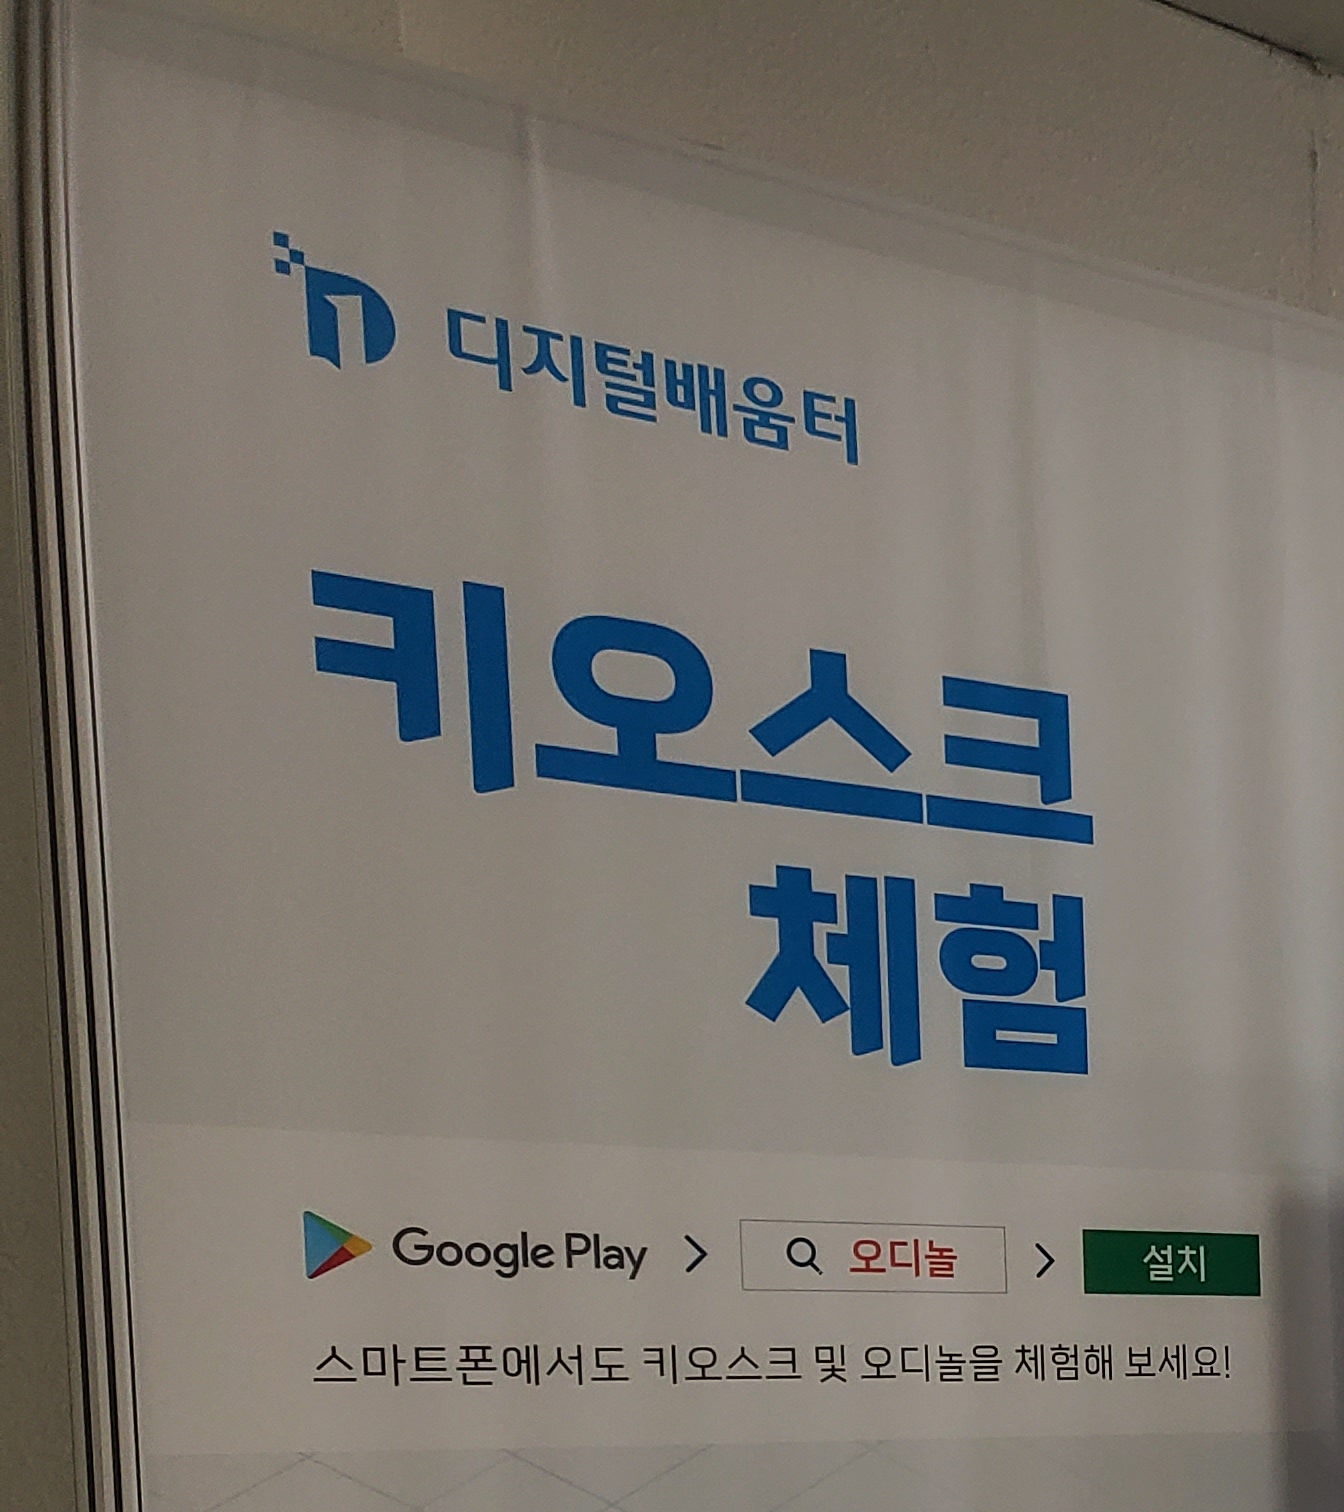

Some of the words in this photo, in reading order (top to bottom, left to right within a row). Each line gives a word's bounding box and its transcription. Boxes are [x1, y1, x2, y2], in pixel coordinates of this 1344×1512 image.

[447, 308, 859, 466] 디지털배움터
[311, 569, 1094, 845] 키오스크
[745, 864, 1089, 1075] 체험
[393, 1226, 555, 1278] Google
[565, 1232, 648, 1280] Play
[849, 1238, 958, 1278] 오디놀
[1142, 1242, 1207, 1283] 설치
[312, 1342, 631, 1387] 스마트폰에서도
[642, 1344, 802, 1383] 키오스크
[816, 1344, 847, 1383] 및
[860, 1343, 1003, 1383] 오디놀을
[1014, 1344, 1114, 1382] 체험해
[1124, 1343, 1231, 1382] 보세요!
